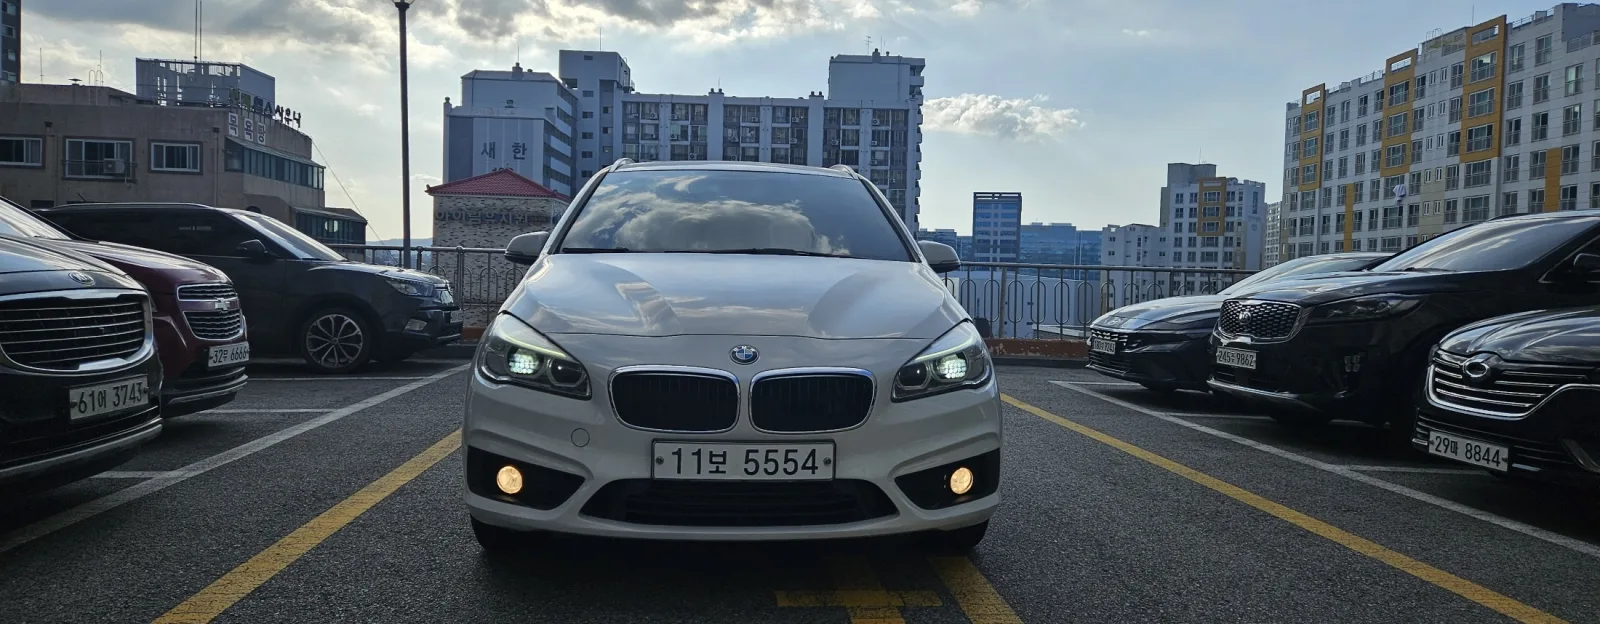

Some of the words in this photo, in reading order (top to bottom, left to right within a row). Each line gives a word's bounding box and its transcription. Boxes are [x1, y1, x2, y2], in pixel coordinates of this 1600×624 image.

[231, 345, 247, 361] 6666
[1237, 352, 1254, 366] 9862
[78, 389, 107, 414] 61어
[112, 381, 143, 407] 3743
[671, 447, 728, 475] 11보
[743, 448, 819, 476] 5554
[1434, 435, 1459, 457] 29마
[1464, 442, 1501, 467] 8844
